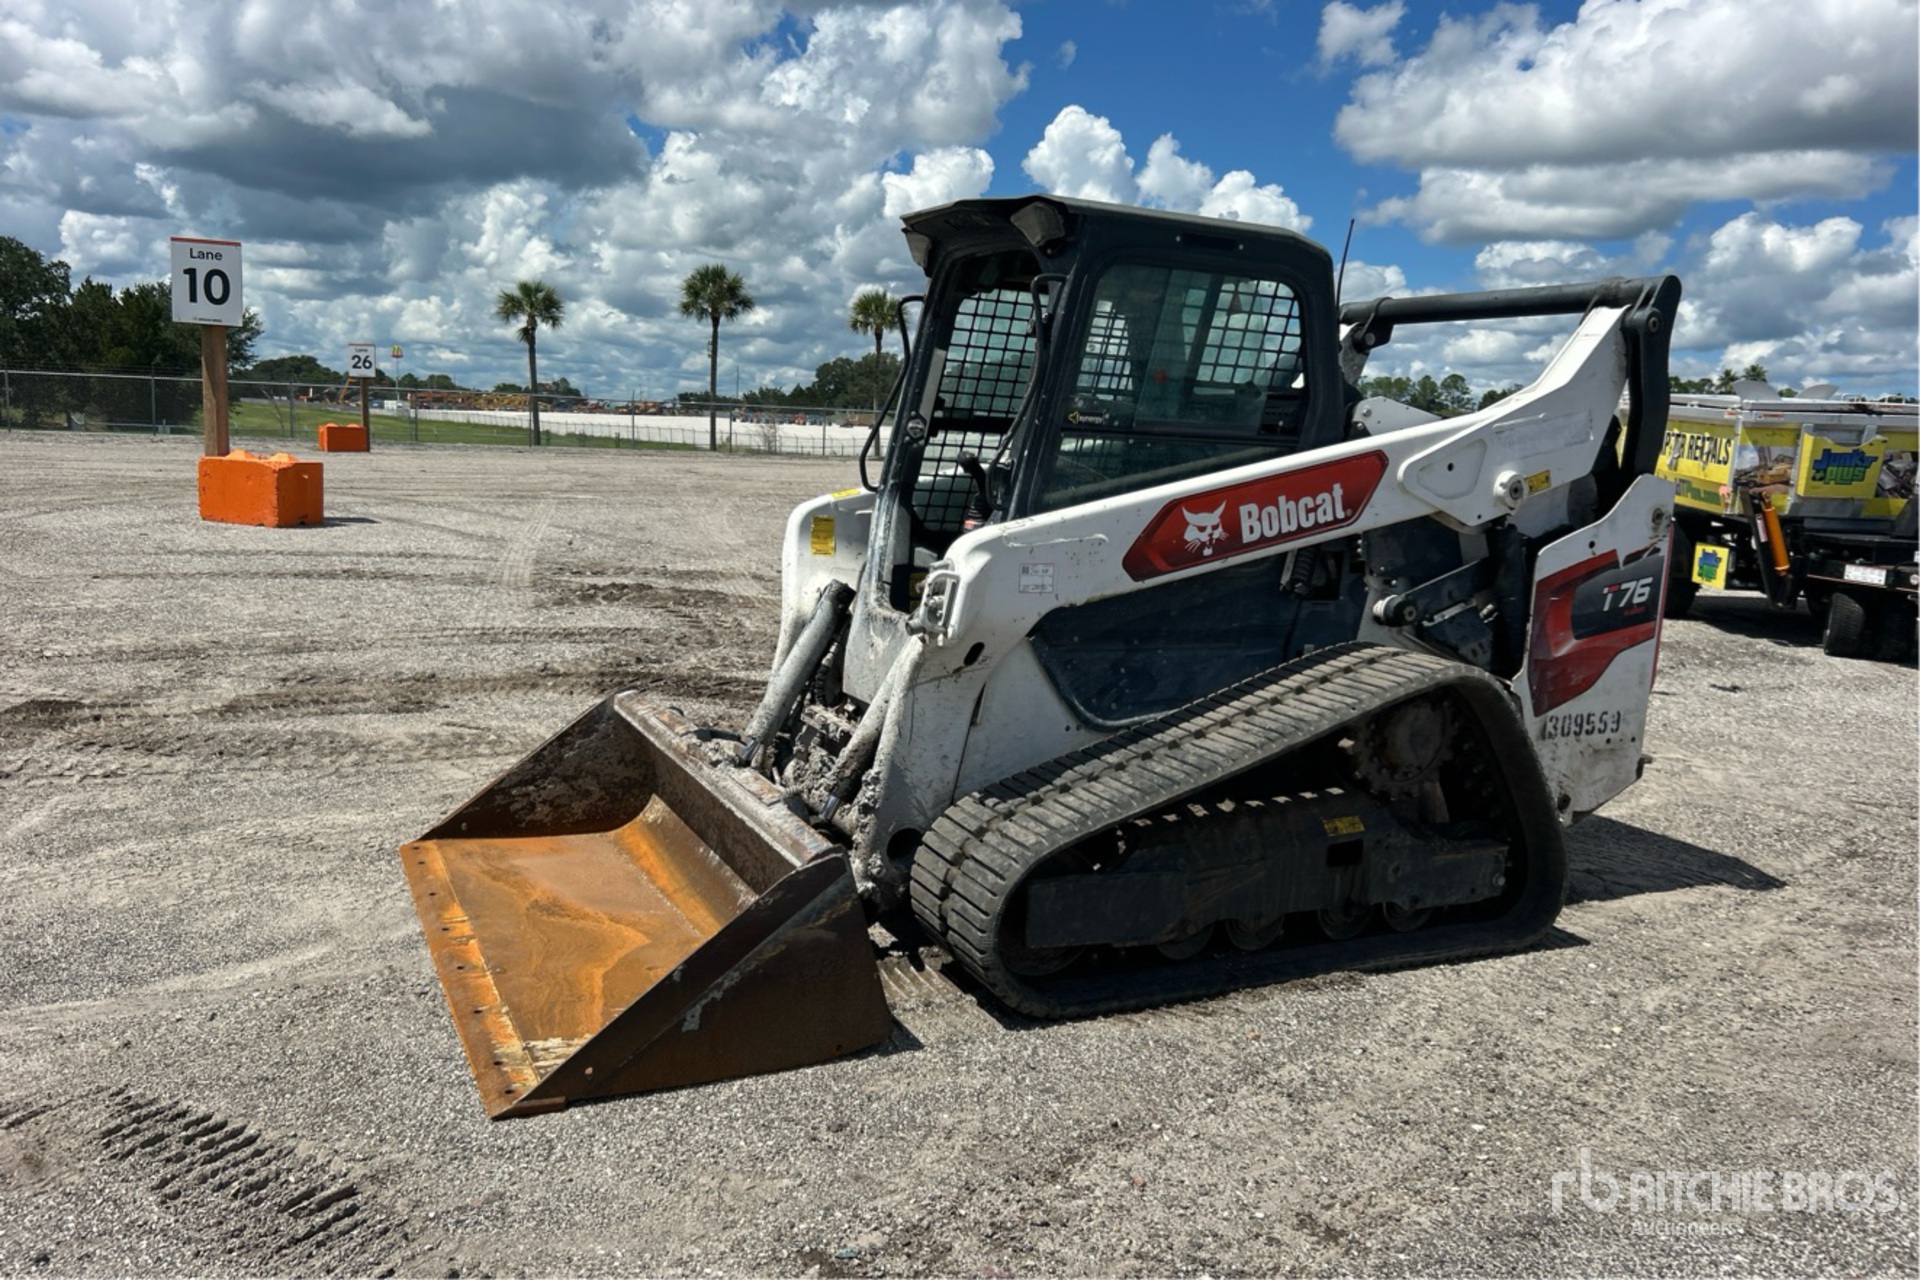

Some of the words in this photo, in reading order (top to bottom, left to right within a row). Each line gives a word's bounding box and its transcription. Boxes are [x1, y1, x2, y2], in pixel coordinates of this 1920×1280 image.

[189, 247, 223, 261] Lane
[183, 267, 231, 306] 10
[351, 354, 373, 370] 26
[1239, 482, 1346, 544] Bobcat
[1602, 576, 1654, 612] T76
